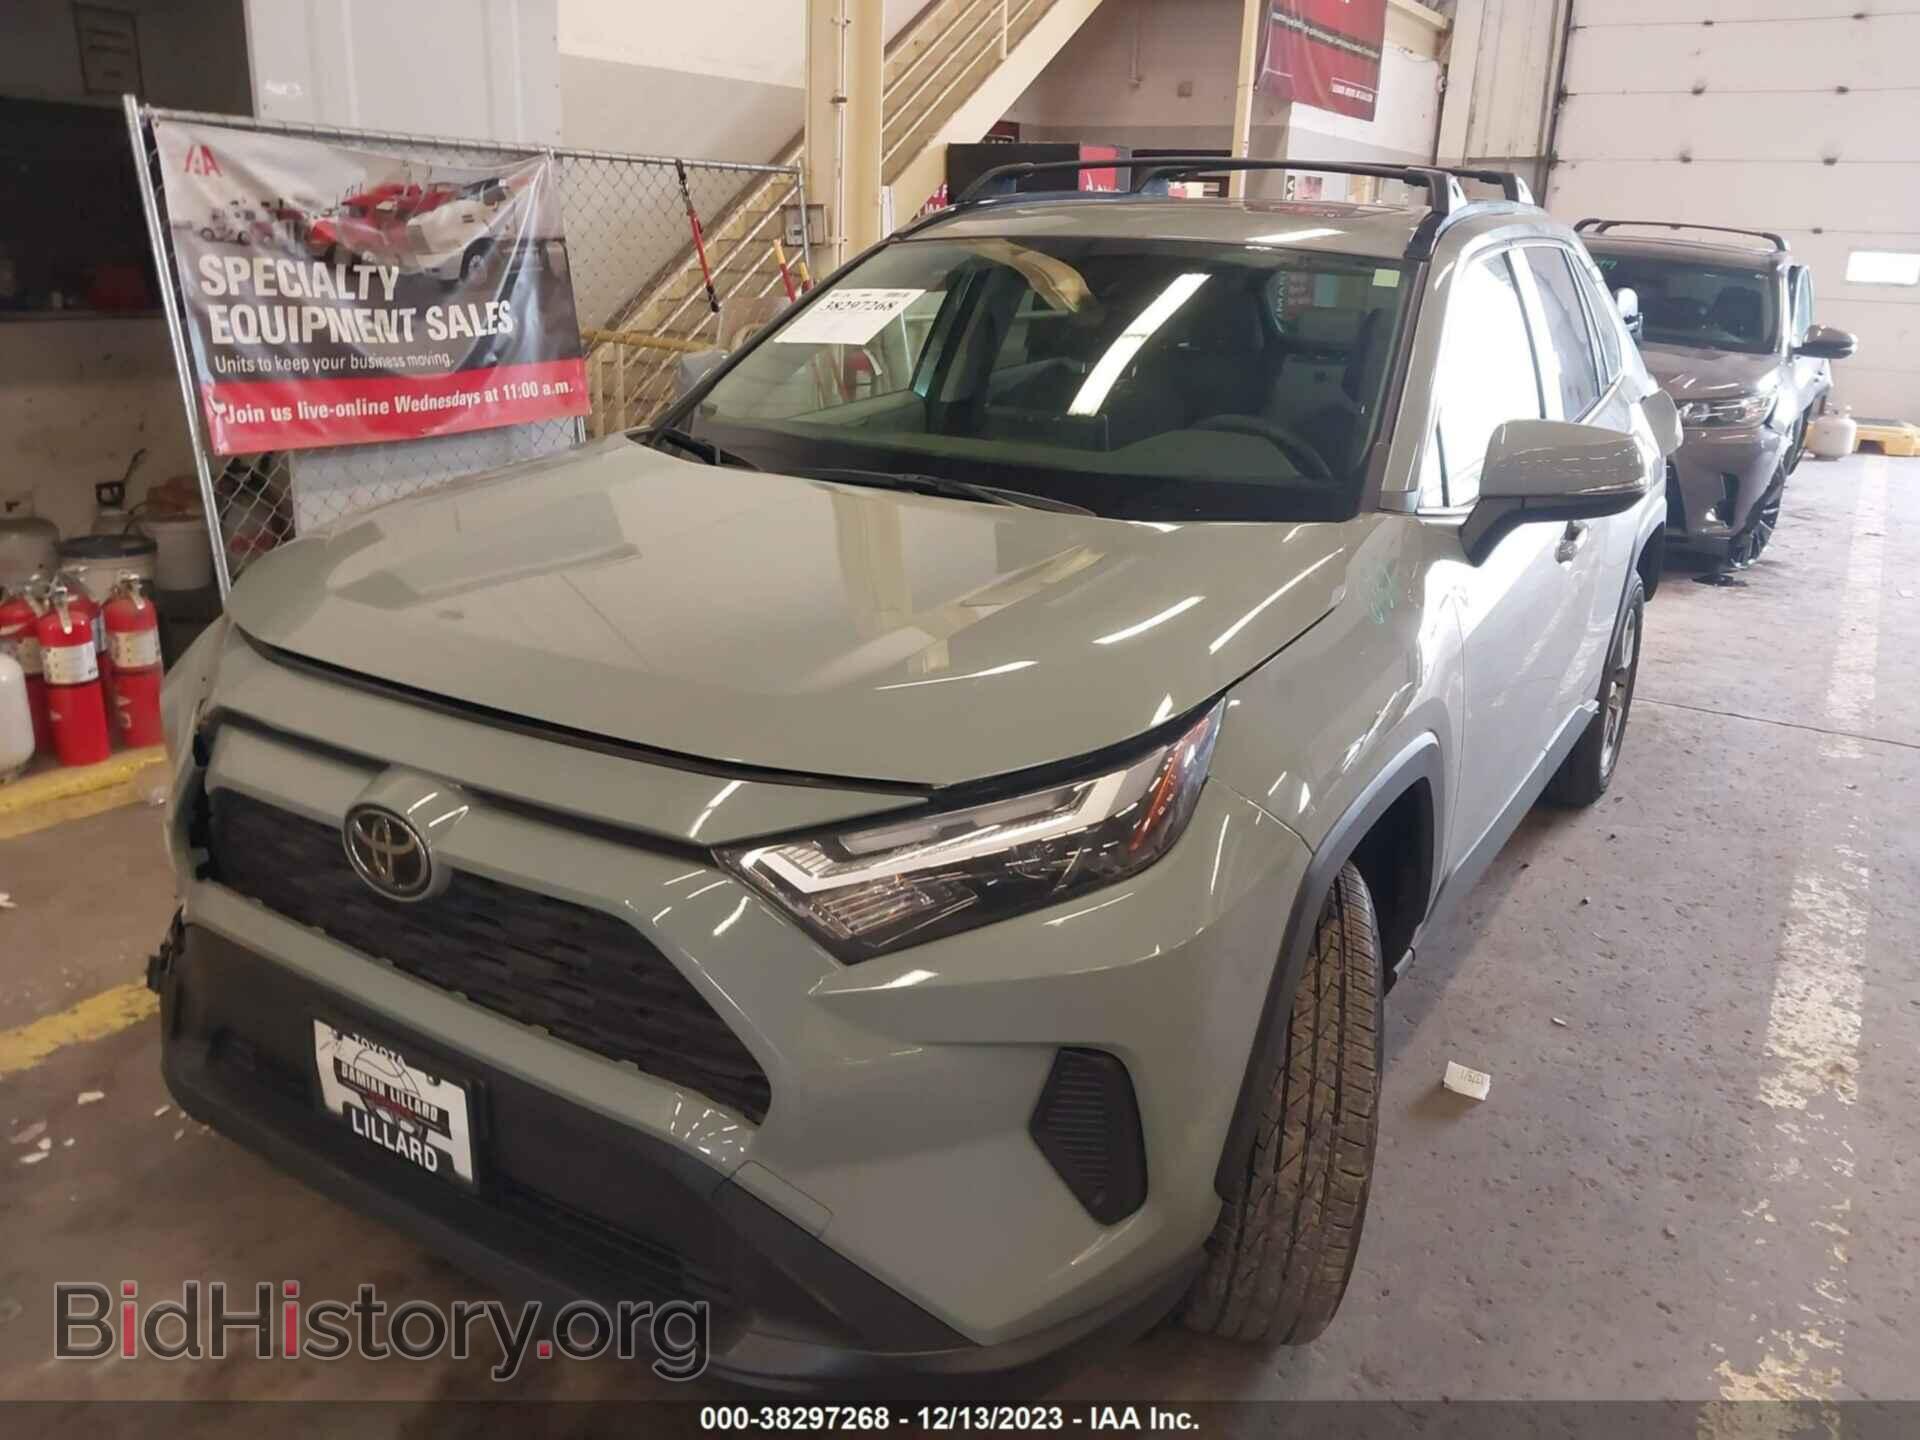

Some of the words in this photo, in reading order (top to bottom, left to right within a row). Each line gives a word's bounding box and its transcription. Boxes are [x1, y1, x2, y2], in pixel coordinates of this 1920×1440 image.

[199, 253, 400, 301] SPECIALTY
[207, 304, 416, 344] EQUIPMENT
[425, 300, 513, 341] SALES
[214, 354, 255, 373] Units
[257, 356, 272, 373] to
[275, 355, 310, 375] keep
[313, 355, 346, 374] your
[350, 353, 406, 370] business
[407, 350, 455, 368] moving.
[224, 403, 263, 425] Join
[271, 405, 293, 422] us
[297, 397, 389, 420] live-online
[394, 388, 481, 414] Wednesdays
[484, 384, 499, 402] at
[503, 381, 539, 400] 11:00
[542, 380, 574, 396] a.m.
[389, 1085, 439, 1122] LILLARD
[351, 1108, 438, 1173] LILLARD
